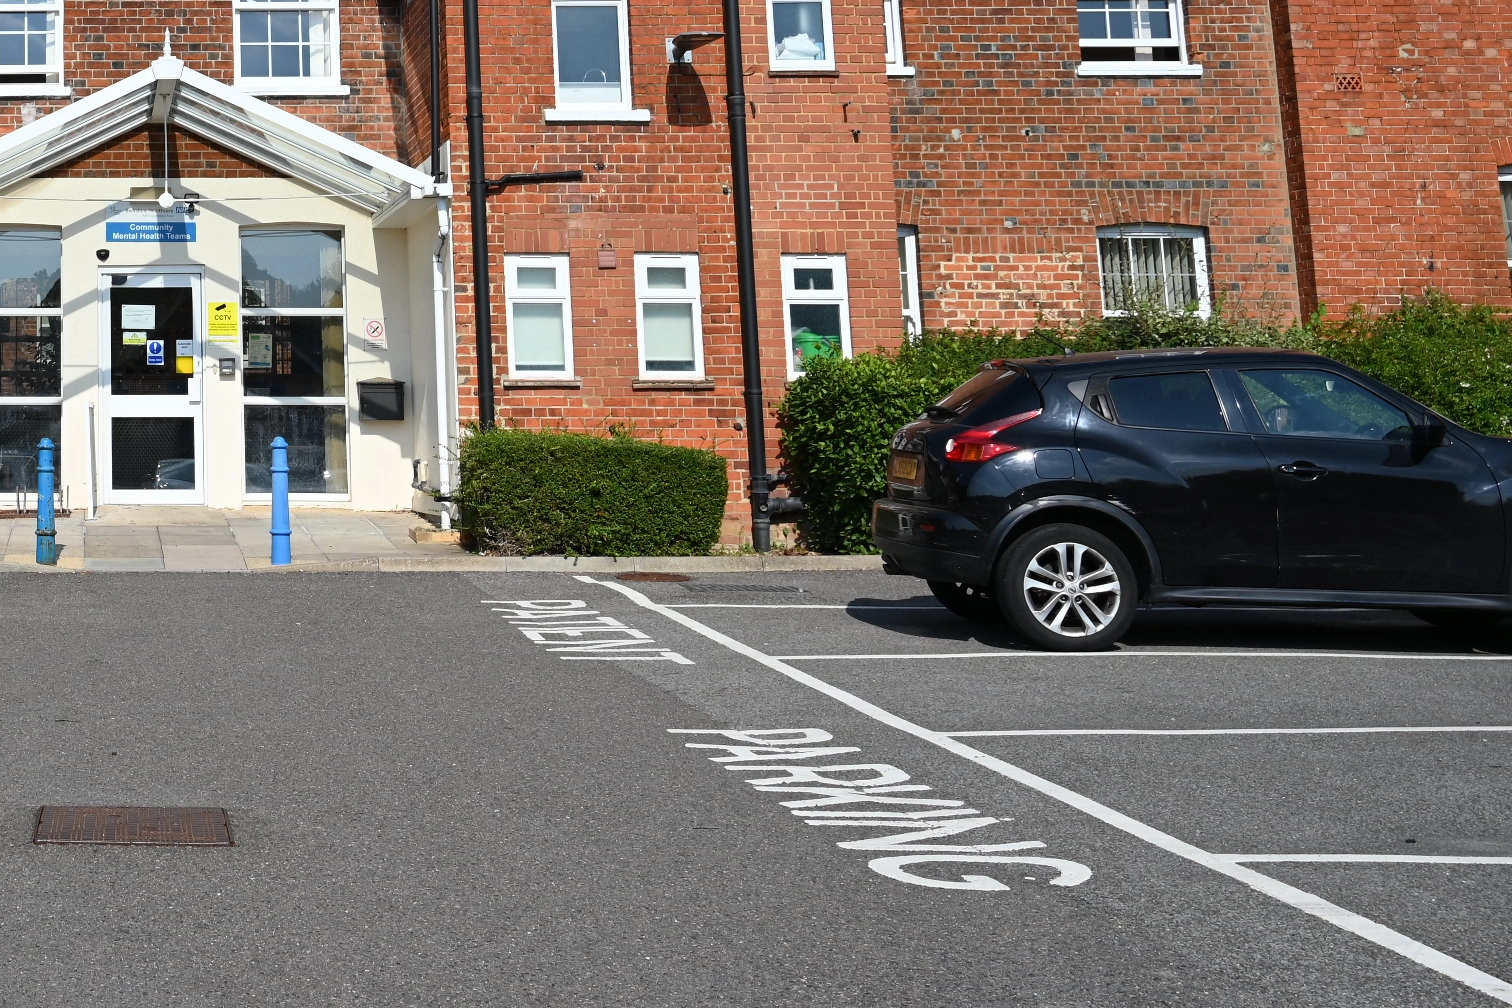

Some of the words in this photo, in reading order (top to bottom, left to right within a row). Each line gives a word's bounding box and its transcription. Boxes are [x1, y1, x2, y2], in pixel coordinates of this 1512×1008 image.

[112, 232, 138, 240] Mental
[139, 232, 164, 240] Health
[167, 232, 191, 240] Teams
[129, 223, 174, 232] Community
[480, 599, 696, 665] PATIENT
[666, 728, 1093, 891] PARKING
